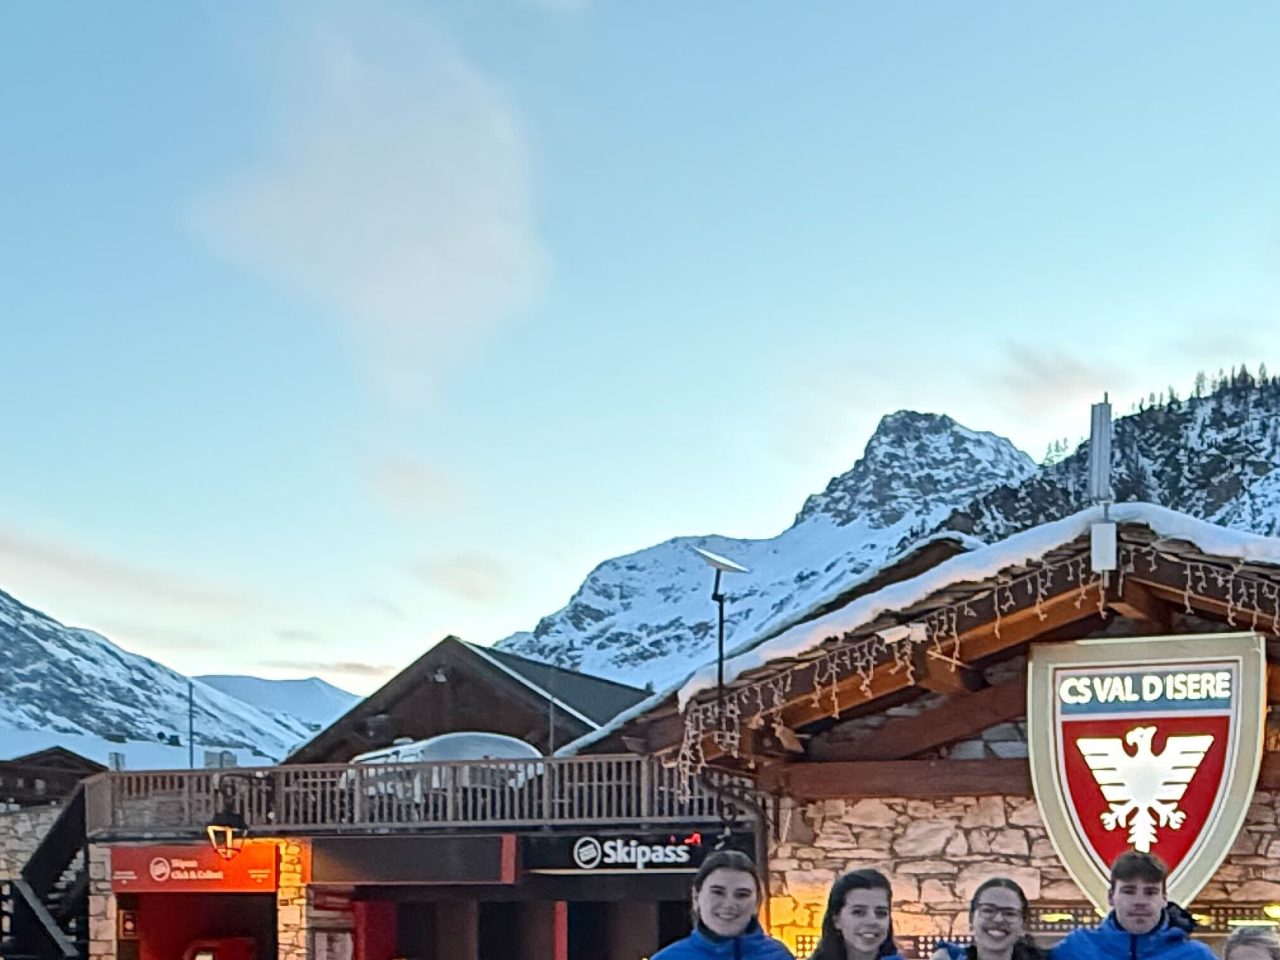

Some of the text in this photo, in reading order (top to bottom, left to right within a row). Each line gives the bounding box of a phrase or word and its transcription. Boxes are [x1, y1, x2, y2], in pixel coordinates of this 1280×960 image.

[1059, 677, 1092, 704] CS
[1093, 675, 1139, 703] VAL
[603, 839, 691, 870] Skipass
